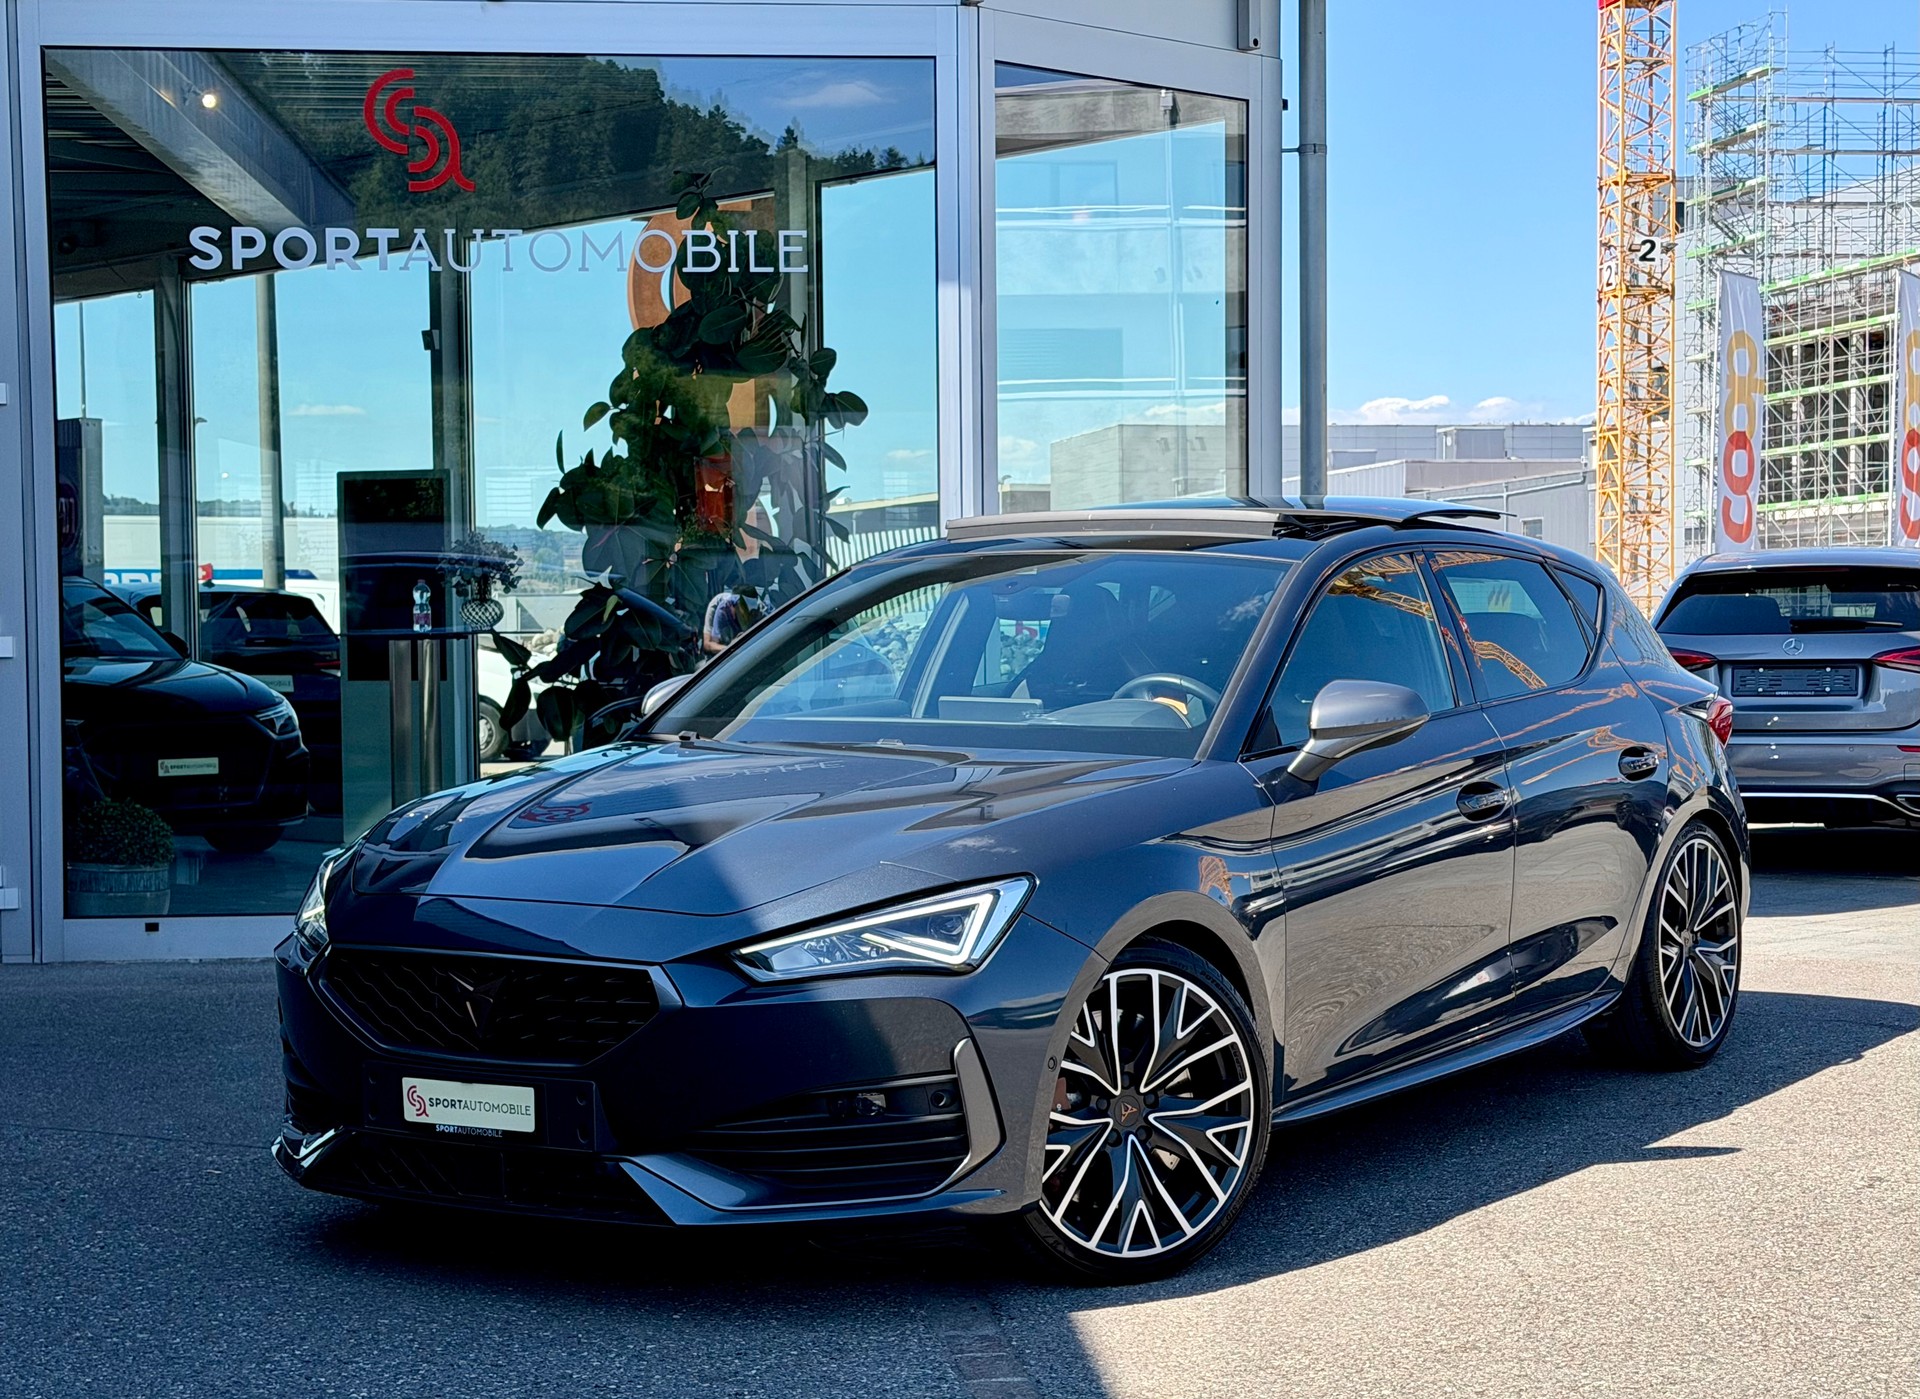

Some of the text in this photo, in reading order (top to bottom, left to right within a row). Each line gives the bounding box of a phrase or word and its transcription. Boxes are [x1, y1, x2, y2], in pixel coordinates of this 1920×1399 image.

[189, 227, 808, 273] SPORTAUTOMOBILE
[1639, 239, 1656, 262] 2
[1606, 265, 1613, 287] 2
[1721, 330, 1766, 543] coop
[428, 1097, 532, 1116] SPORTAUTOMOBILE
[435, 1124, 503, 1138] SPORTAUTOMOBILE
